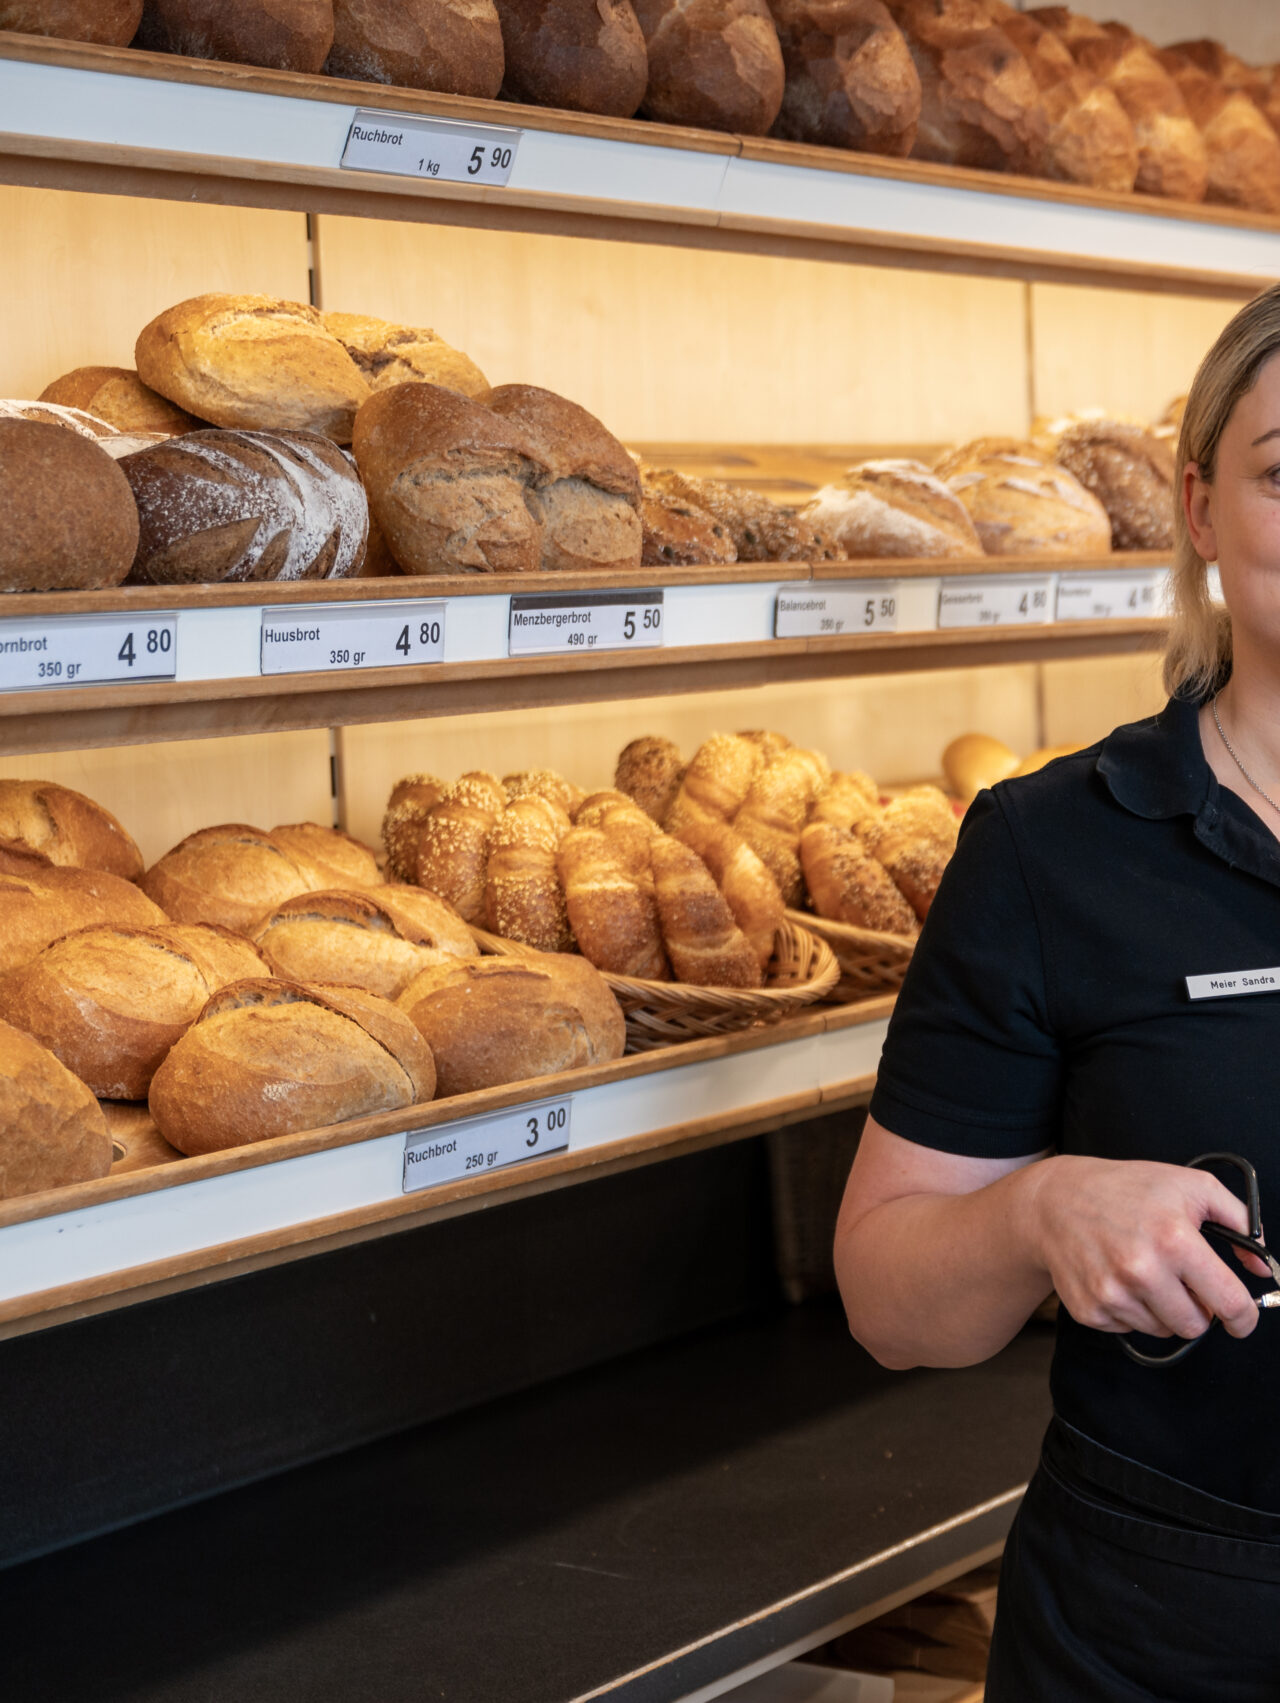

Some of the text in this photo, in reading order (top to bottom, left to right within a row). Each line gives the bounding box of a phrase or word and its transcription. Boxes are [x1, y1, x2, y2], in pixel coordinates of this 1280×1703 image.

[352, 126, 403, 146] Ruchbrot
[418, 158, 441, 176] 1 kg
[468, 146, 512, 175] 5 90
[864, 598, 896, 626] 5 50
[1018, 592, 1029, 616] 4
[513, 611, 592, 628] Menzbergerbrot
[623, 608, 661, 640] 5 50
[264, 627, 320, 643] Huusbrot
[395, 621, 441, 656] 4 80
[567, 633, 598, 648] 490 gr
[118, 628, 172, 667] 4 80
[329, 649, 366, 666] 350 gr
[38, 661, 82, 679] 350 gr
[1210, 975, 1276, 990] Meier Sandra
[525, 1107, 566, 1148] 3 00
[407, 1139, 458, 1166] Ruchbrot
[465, 1151, 499, 1170] 250 gr
